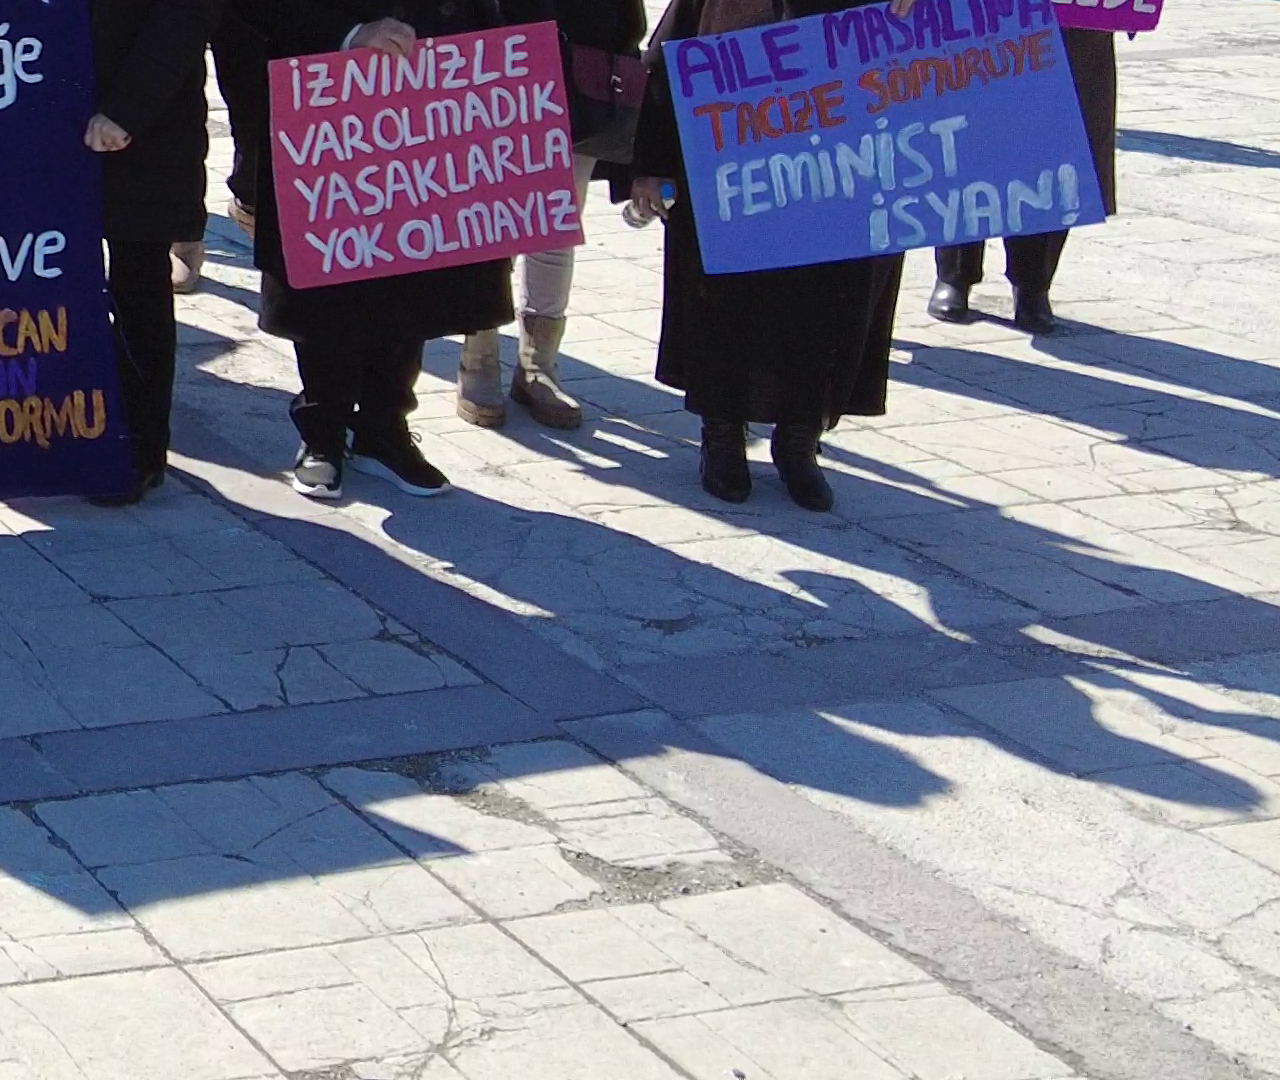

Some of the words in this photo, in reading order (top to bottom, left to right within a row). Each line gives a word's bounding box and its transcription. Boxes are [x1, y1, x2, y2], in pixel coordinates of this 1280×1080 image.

[675, 24, 809, 99] AİLE
[692, 77, 850, 153] TACİZE
[855, 28, 1060, 116] SÖMÜRÜYE
[292, 126, 573, 223] YASAKLARLA
[714, 114, 970, 223] FEMİNİST
[867, 162, 1082, 252] İSYAN!
[304, 221, 395, 275] YOK
[395, 188, 582, 263] OLMAYIZ
